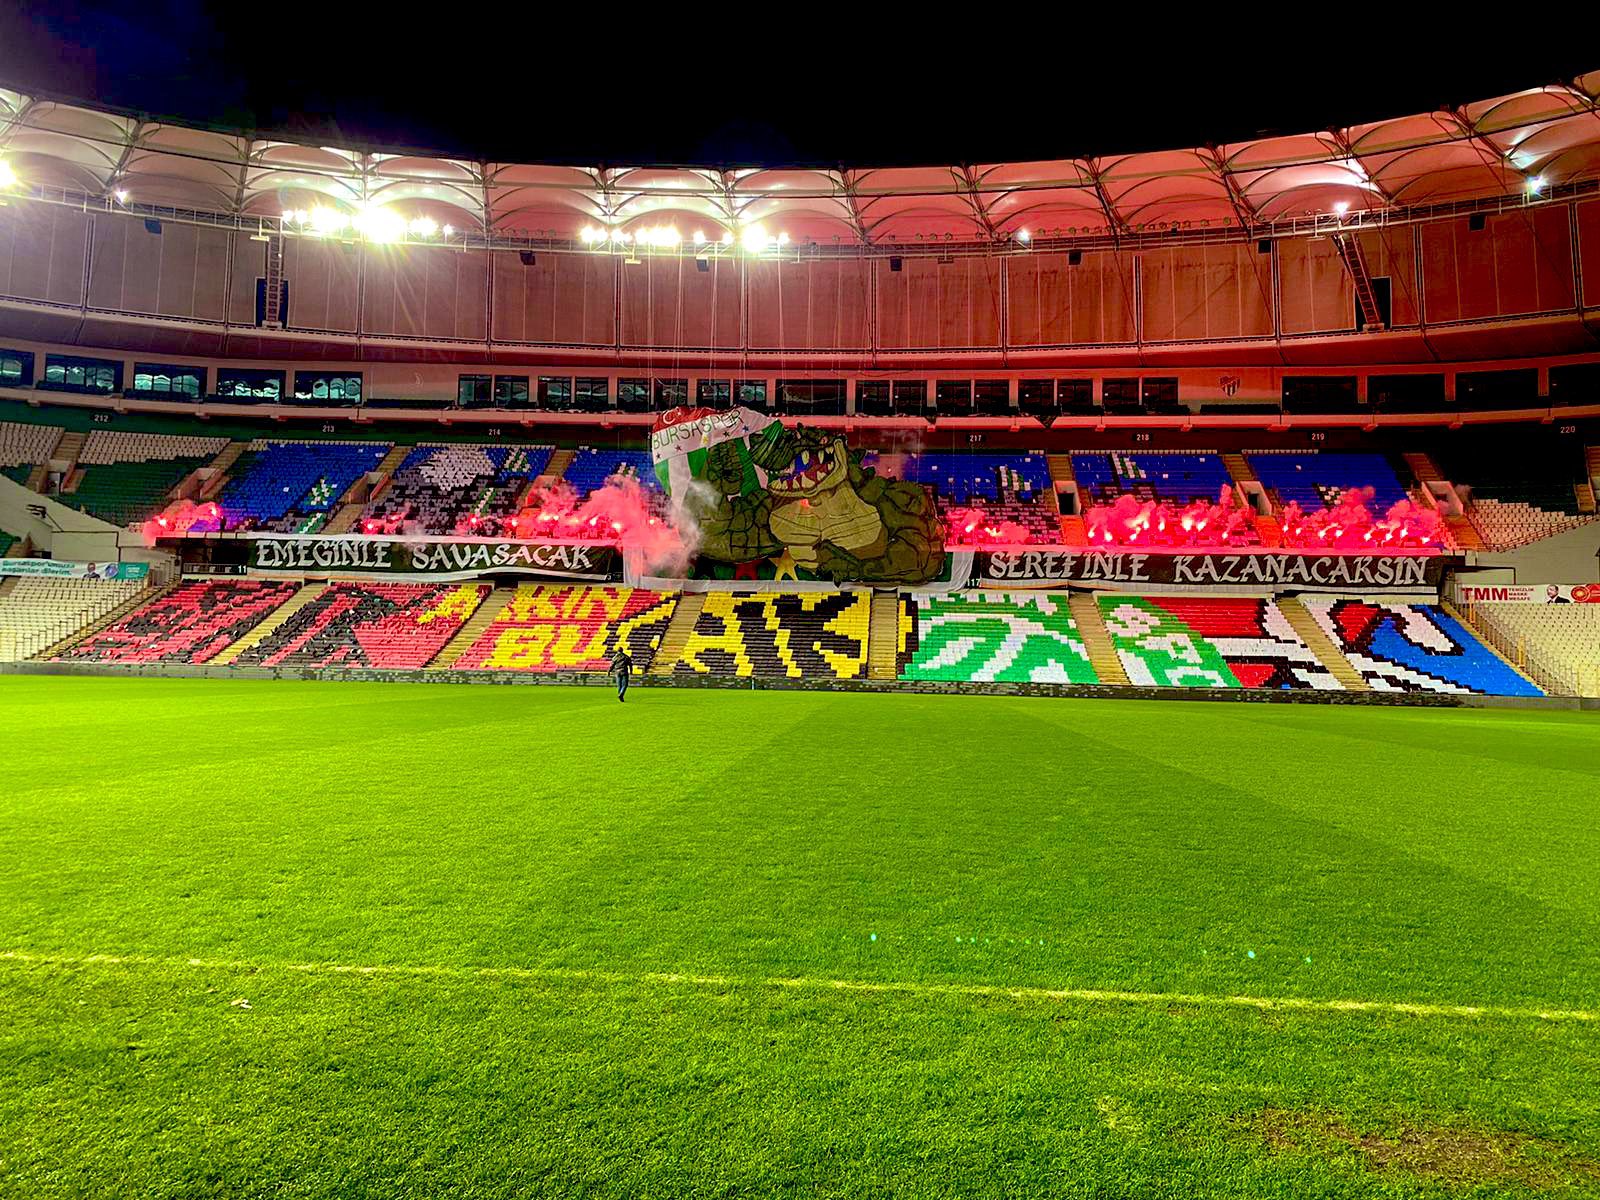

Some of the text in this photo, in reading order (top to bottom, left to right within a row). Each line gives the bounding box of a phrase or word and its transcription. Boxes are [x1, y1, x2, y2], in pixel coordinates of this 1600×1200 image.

[94, 414, 109, 422] 212
[322, 425, 335, 433] 213
[1173, 555, 1430, 584] KAZANACAKSIN
[1461, 587, 1508, 600] TMM
